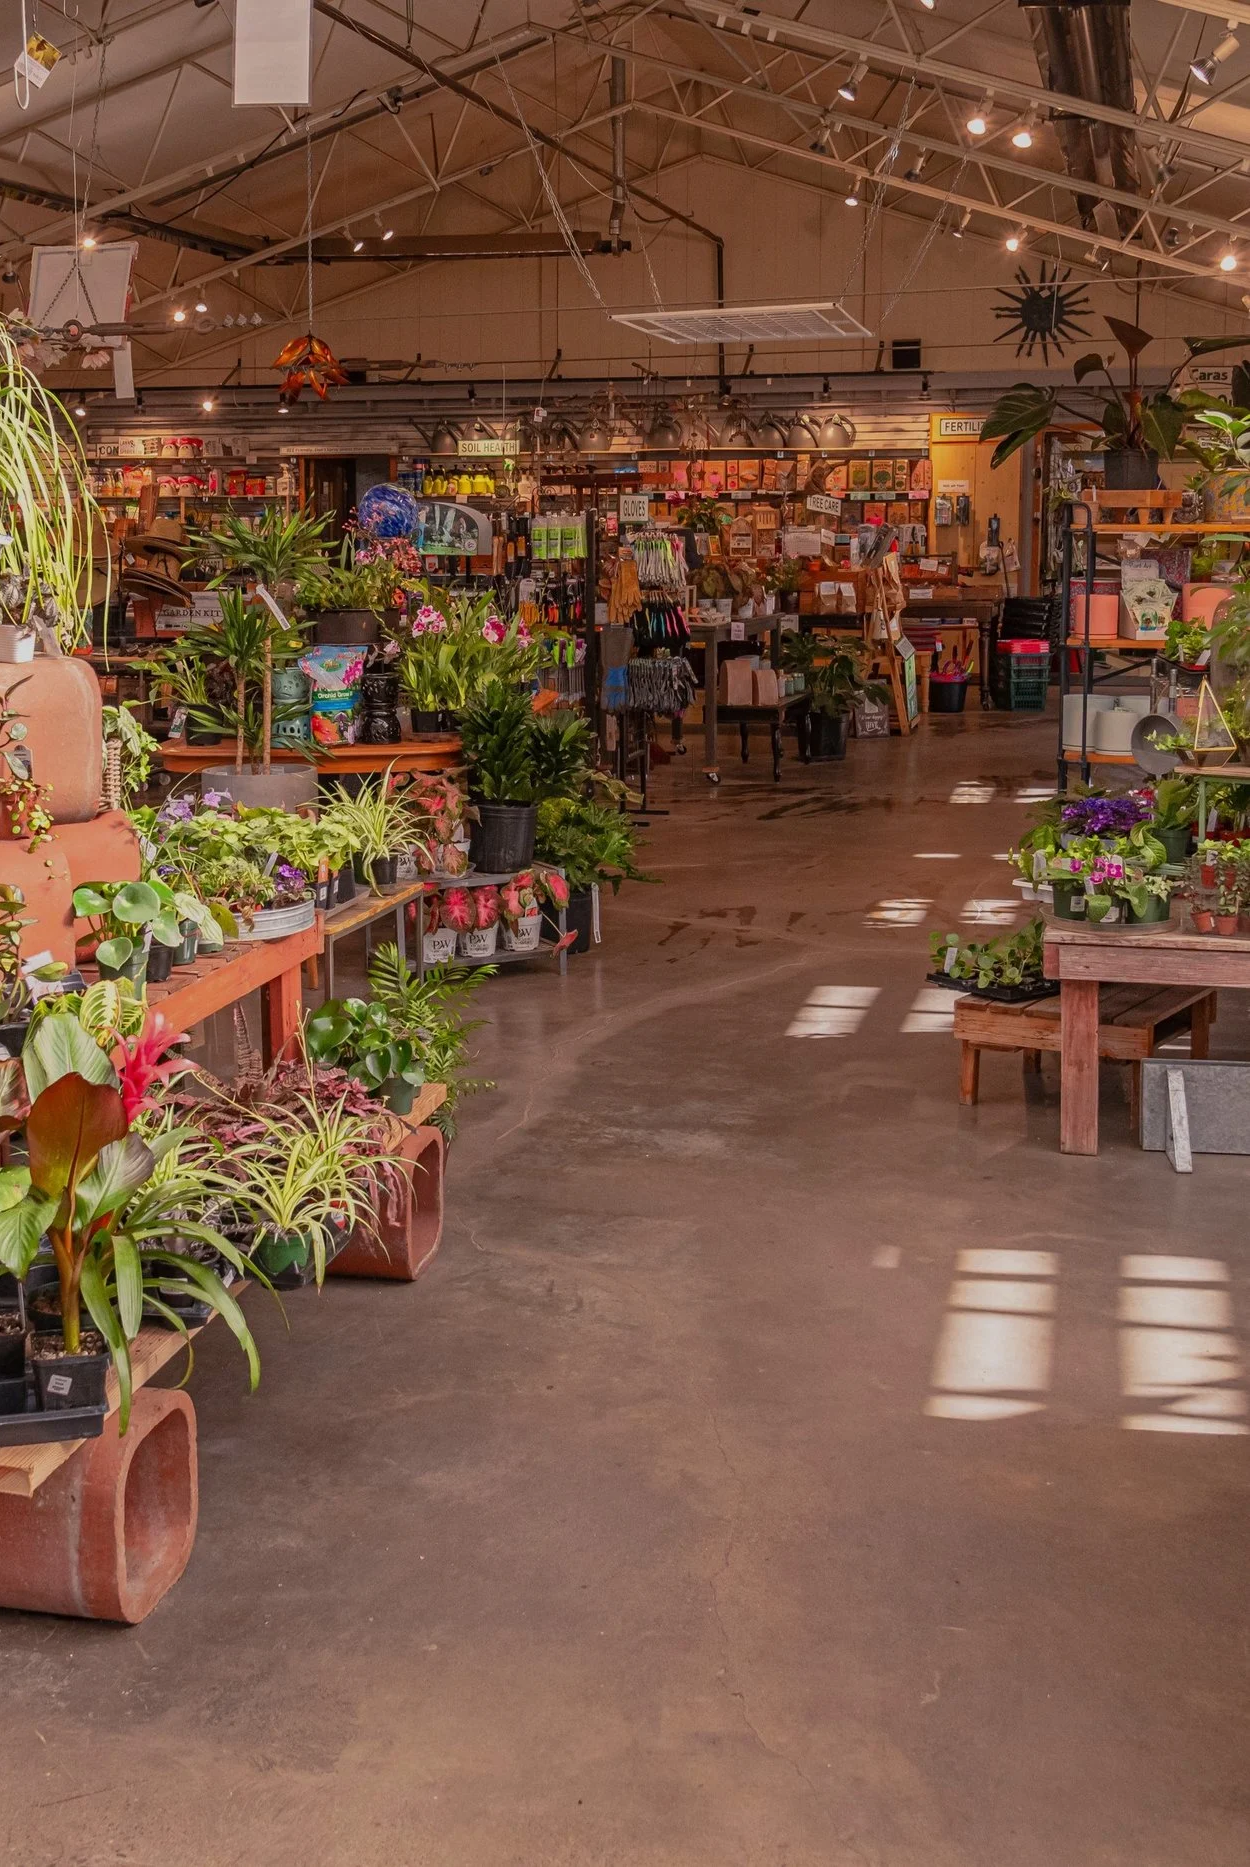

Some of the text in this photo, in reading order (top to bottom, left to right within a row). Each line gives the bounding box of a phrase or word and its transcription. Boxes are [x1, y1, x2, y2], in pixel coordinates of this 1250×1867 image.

[461, 442, 515, 453] SOIL HEALTH
[623, 500, 645, 518] GLOVES
[824, 499, 839, 513] CARE
[163, 608, 222, 617] GARDEN KIT
